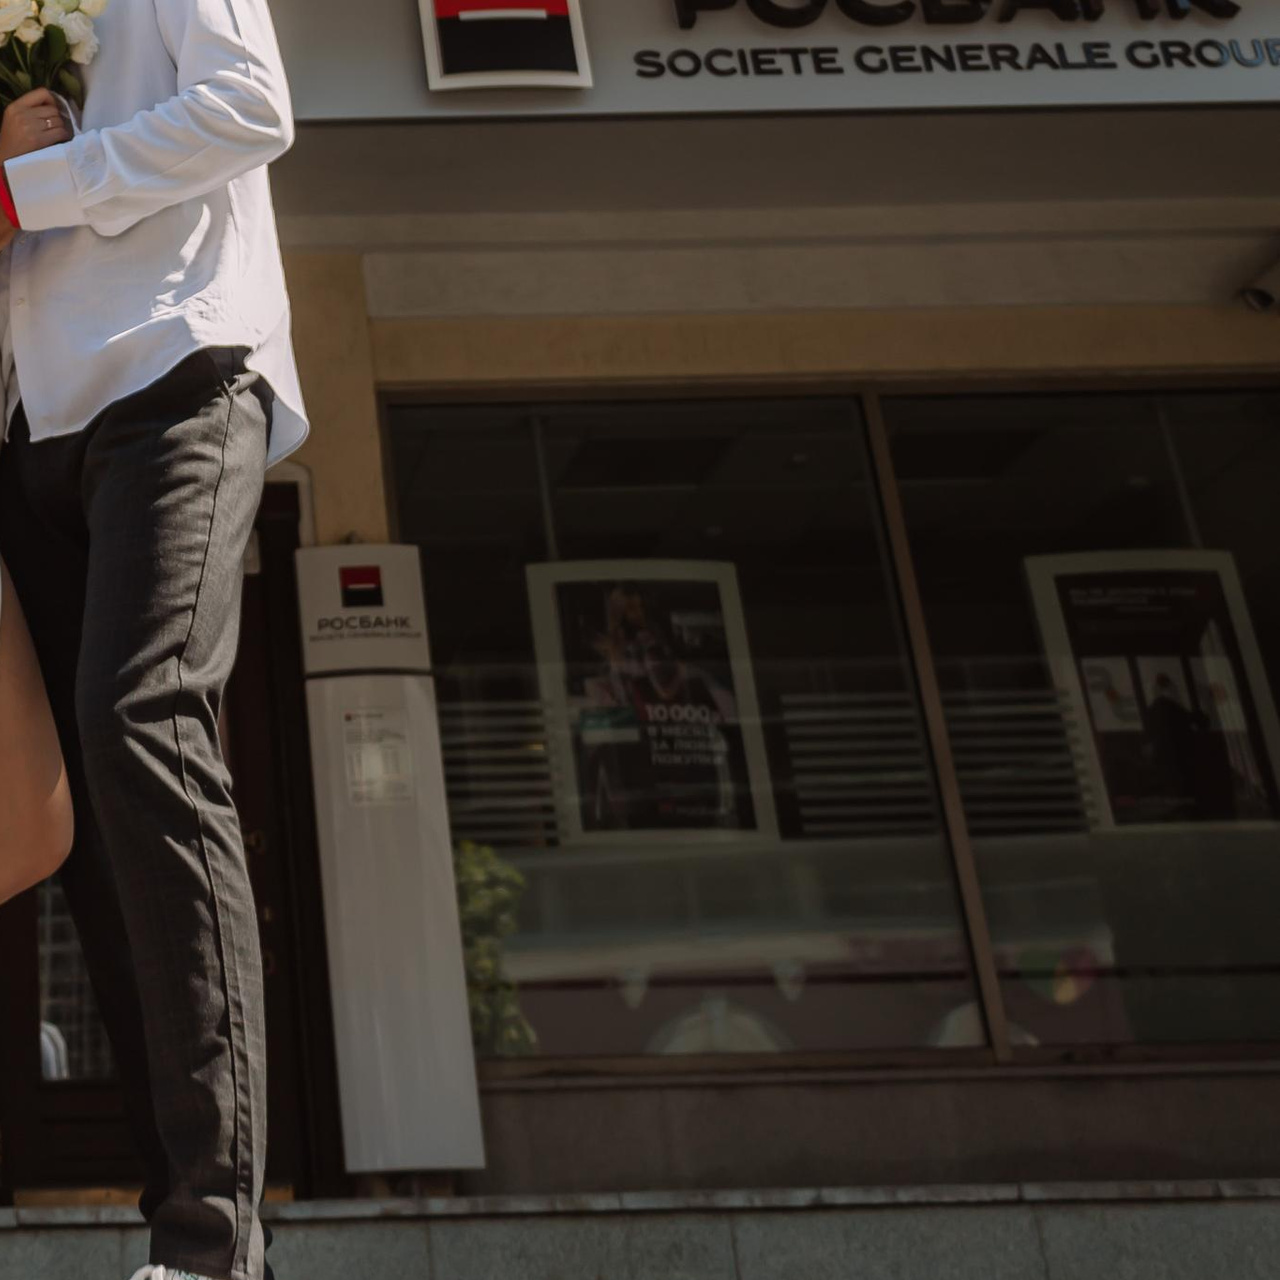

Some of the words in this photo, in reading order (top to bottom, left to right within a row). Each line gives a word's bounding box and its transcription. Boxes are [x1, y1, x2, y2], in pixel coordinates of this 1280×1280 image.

[634, 48, 845, 78] SOCIETE
[854, 41, 1117, 75] GENERALE
[317, 615, 411, 631] РОСБАНК
[645, 704, 667, 721] 10
